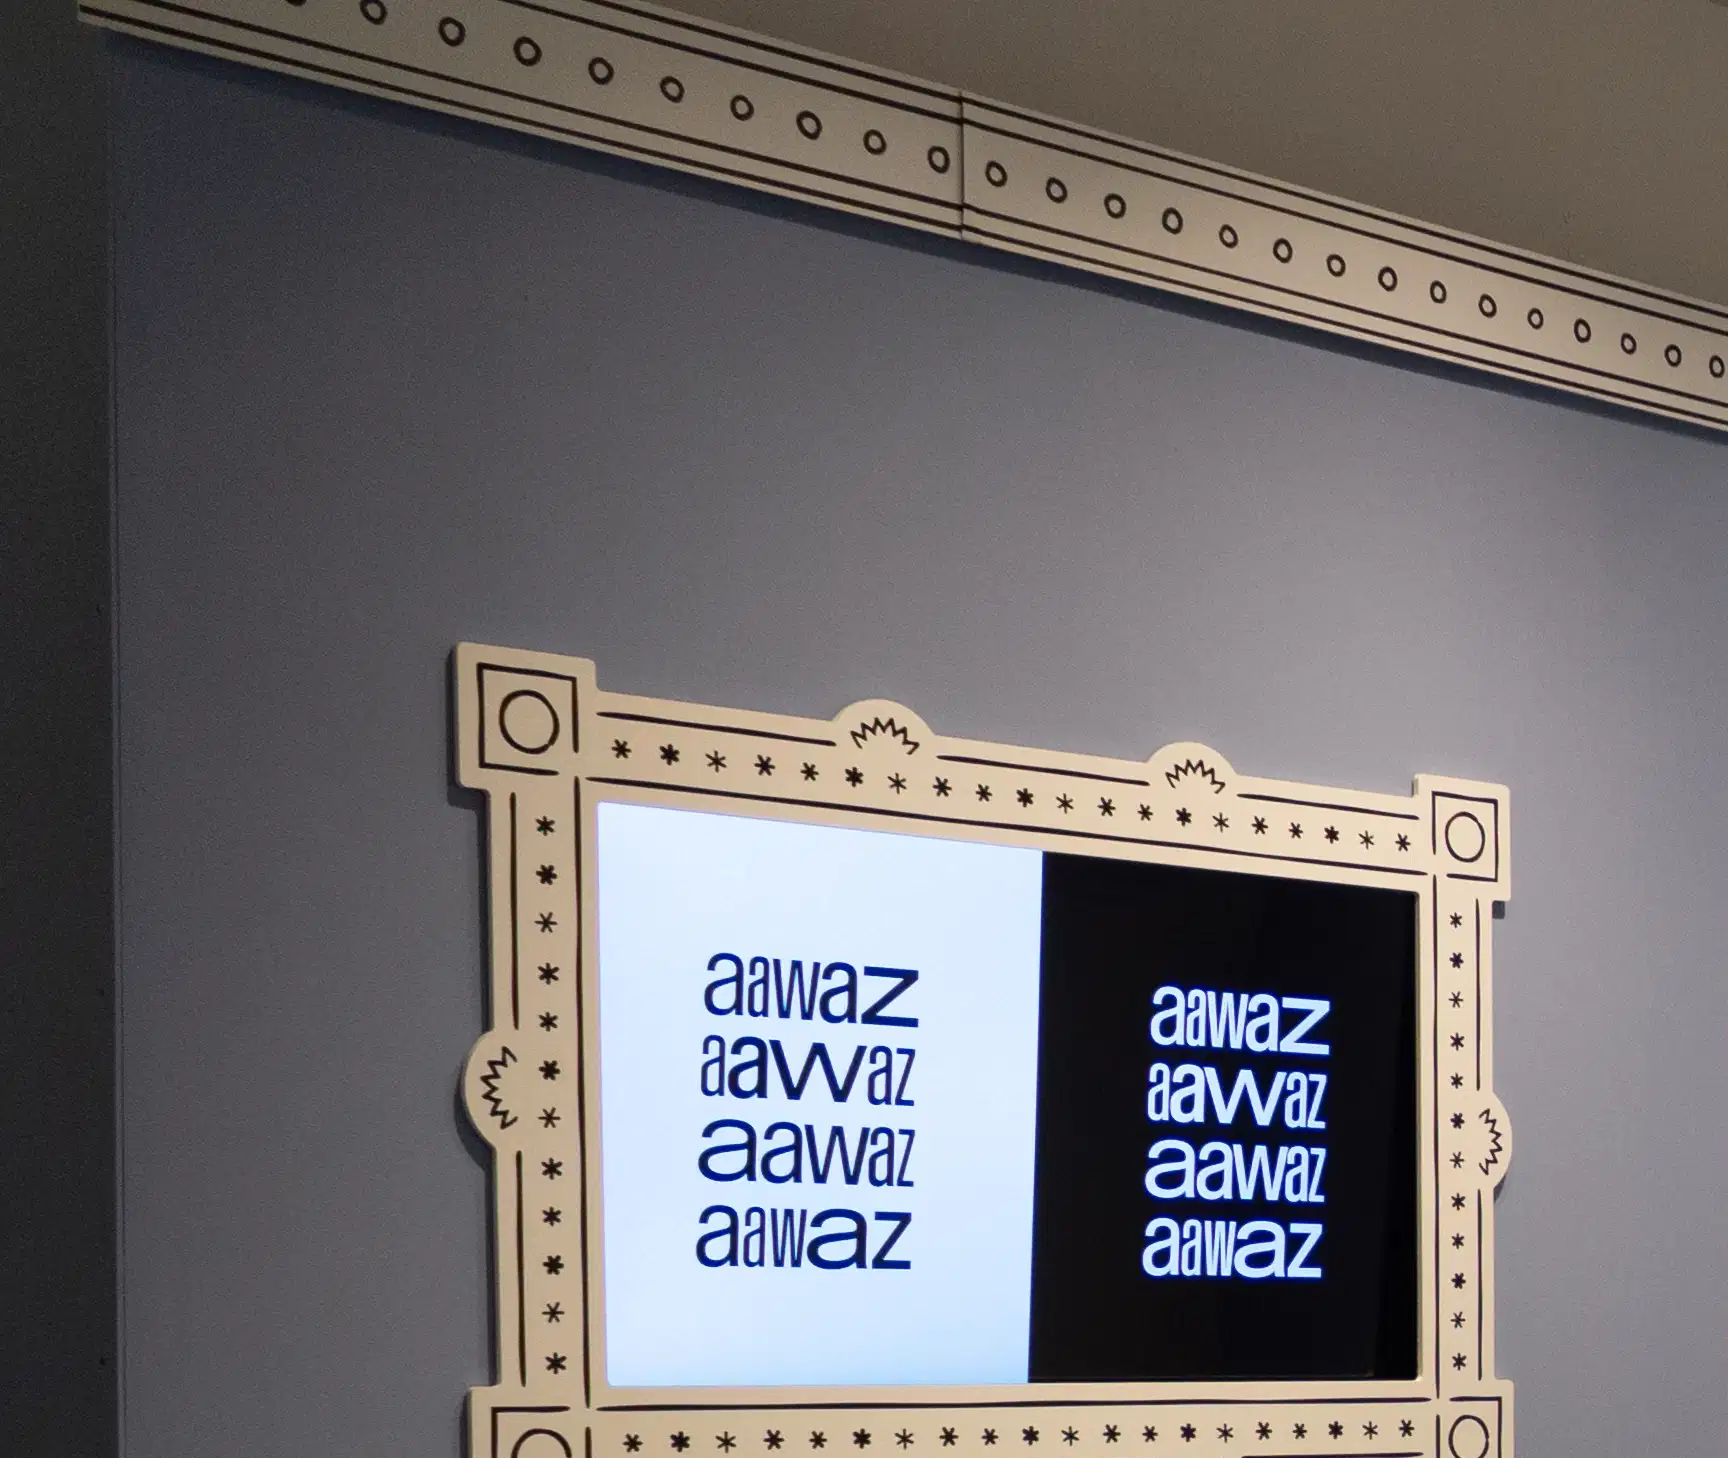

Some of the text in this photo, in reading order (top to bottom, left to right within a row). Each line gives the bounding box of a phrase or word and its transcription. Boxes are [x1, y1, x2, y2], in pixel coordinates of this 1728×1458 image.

[705, 953, 918, 1027] aawaz
[1151, 986, 1330, 1055] aawaz
[701, 1035, 915, 1106] aawaz
[1148, 1063, 1326, 1128] aawaz
[698, 1119, 915, 1187] aawaz
[1145, 1140, 1326, 1202] aawaz
[696, 1205, 911, 1269] aawaz
[1143, 1218, 1322, 1278] aawaz
